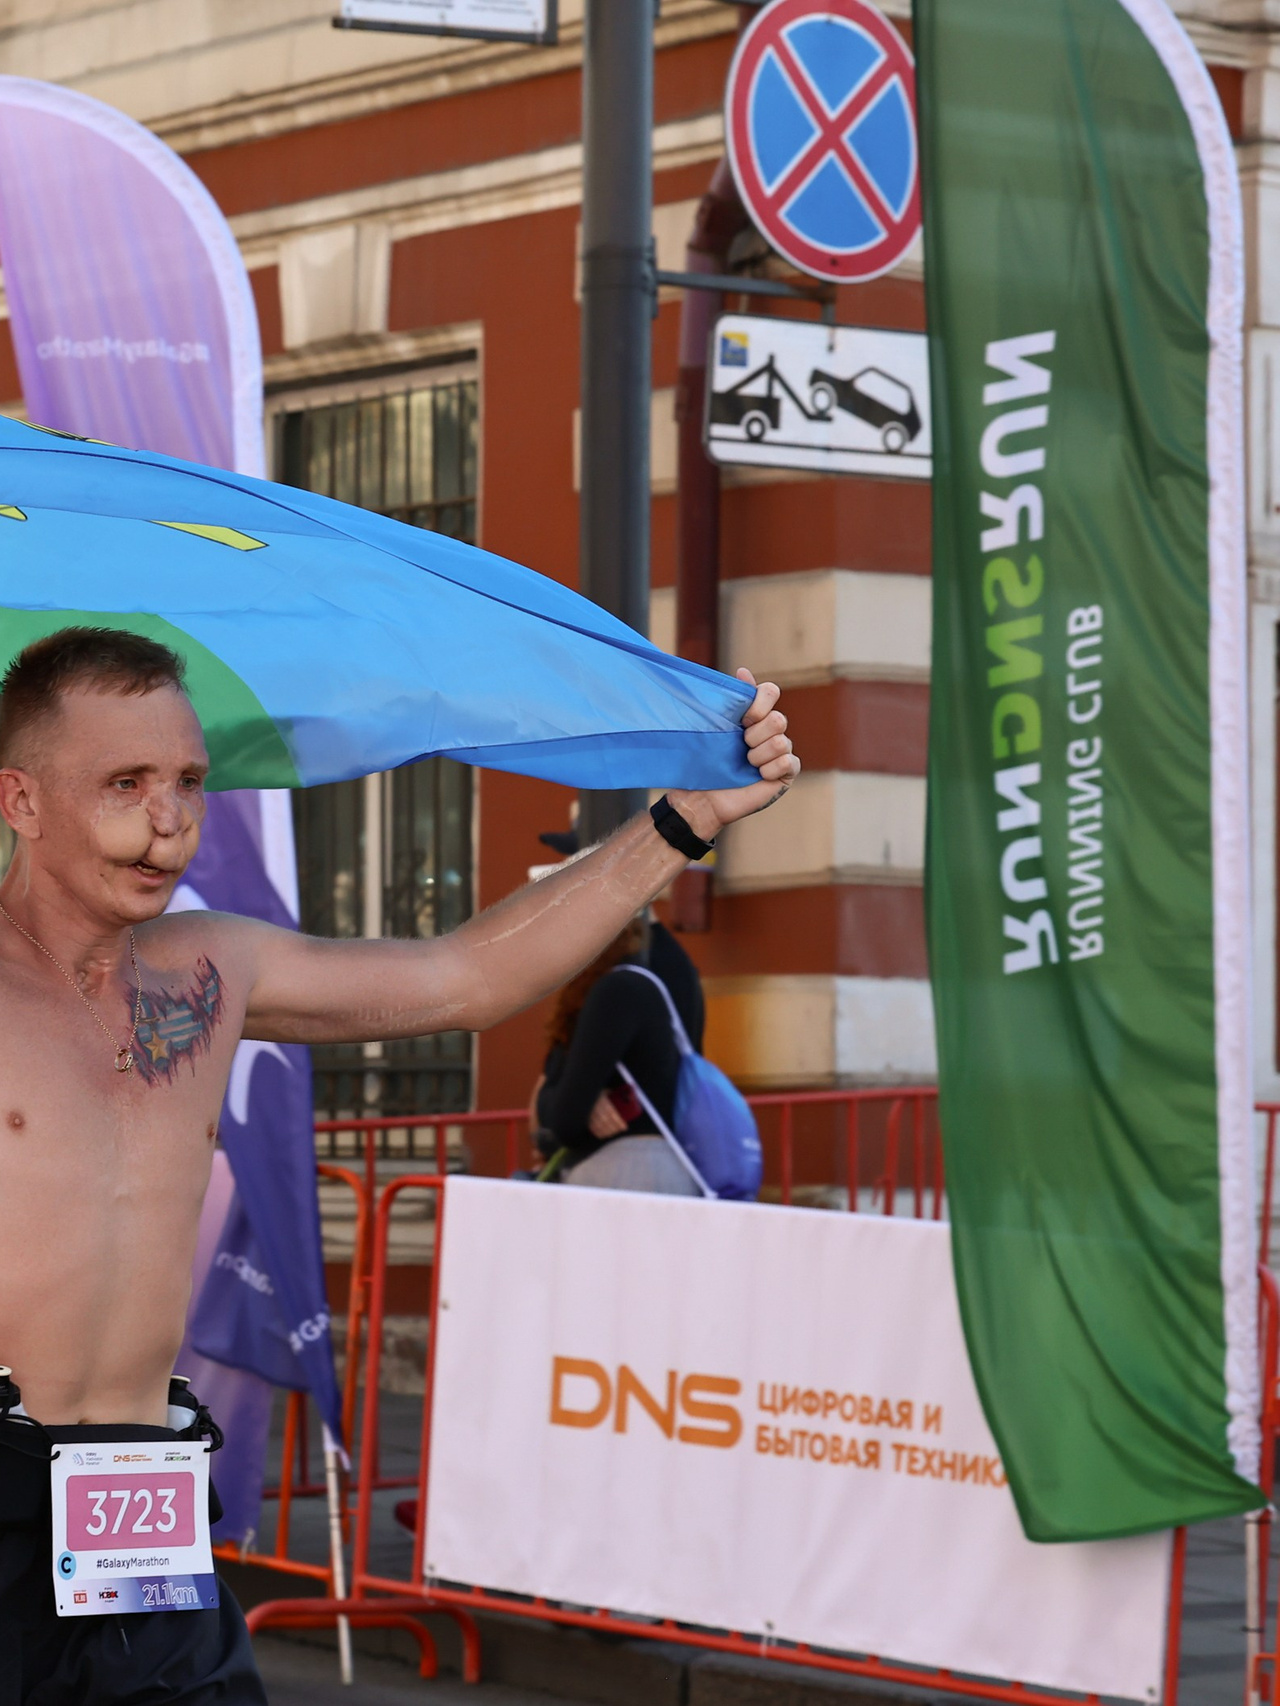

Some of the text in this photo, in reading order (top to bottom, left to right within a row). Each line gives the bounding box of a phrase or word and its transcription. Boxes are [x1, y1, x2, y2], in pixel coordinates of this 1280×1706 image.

[549, 1356, 744, 1449] DNS
[757, 1381, 943, 1435] ЦИФРОВАЯ И
[754, 1425, 882, 1471] БЫТОВАЯ
[85, 1488, 177, 1536] 3723
[60, 1556, 72, 1574] C
[96, 1556, 170, 1569] #GalaxyMarathon
[141, 1582, 199, 1607] 21.1km
